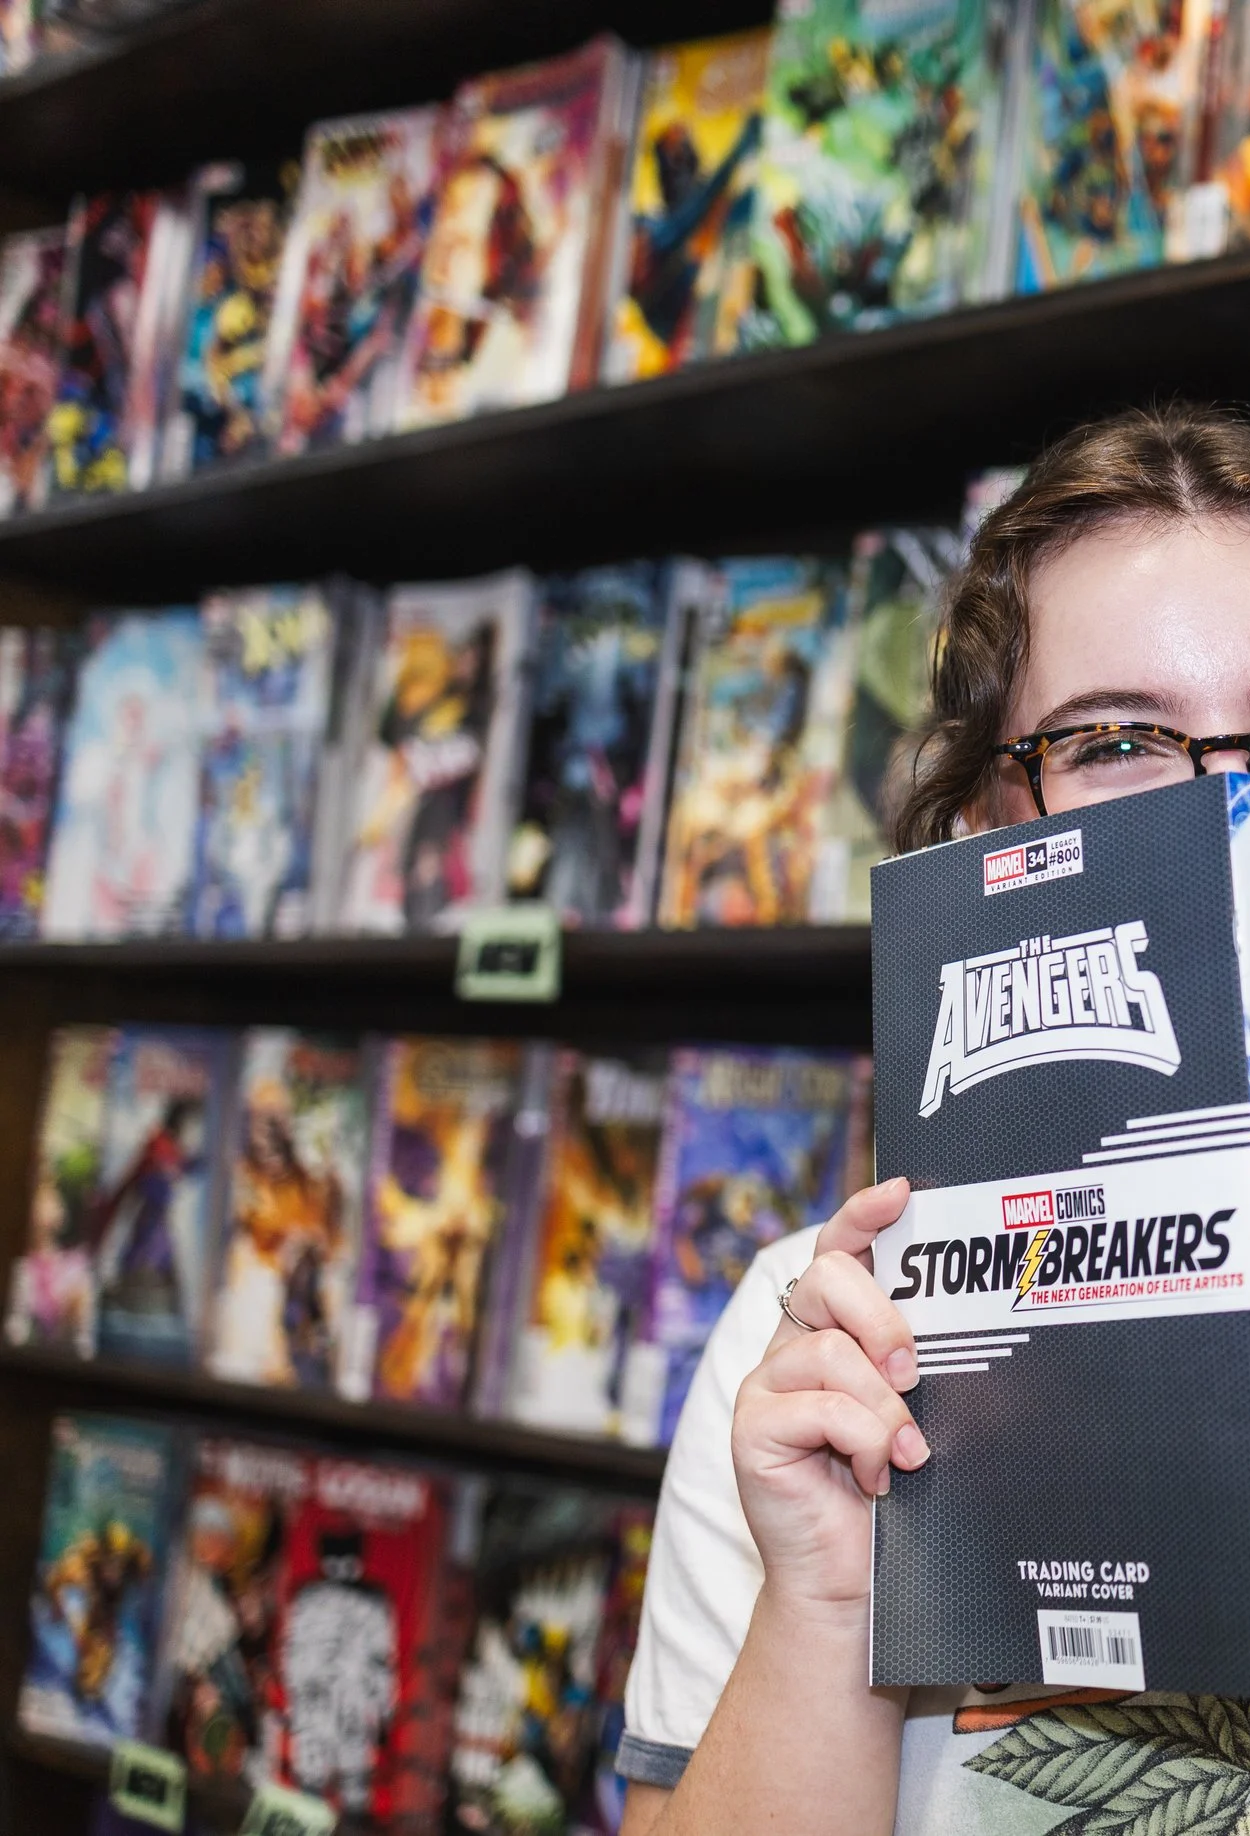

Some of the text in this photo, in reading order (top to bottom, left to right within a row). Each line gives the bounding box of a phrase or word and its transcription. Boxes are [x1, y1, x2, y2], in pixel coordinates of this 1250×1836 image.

[1051, 838, 1077, 850] LEGACY
[988, 846, 1080, 881] MARVEL 34 #800
[991, 867, 1073, 892] VARIANT EDITION
[1019, 935, 1051, 958] THE
[918, 919, 1181, 1118] AVENGERS
[1004, 1188, 1105, 1226] MARVEL COMICS
[1031, 1273, 1245, 1305] THE NEXT GENERATION OF ELITE ARTISTS
[1017, 1560, 1150, 1583] TRADING CARD
[1037, 1583, 1134, 1600] VARIANT COVER
